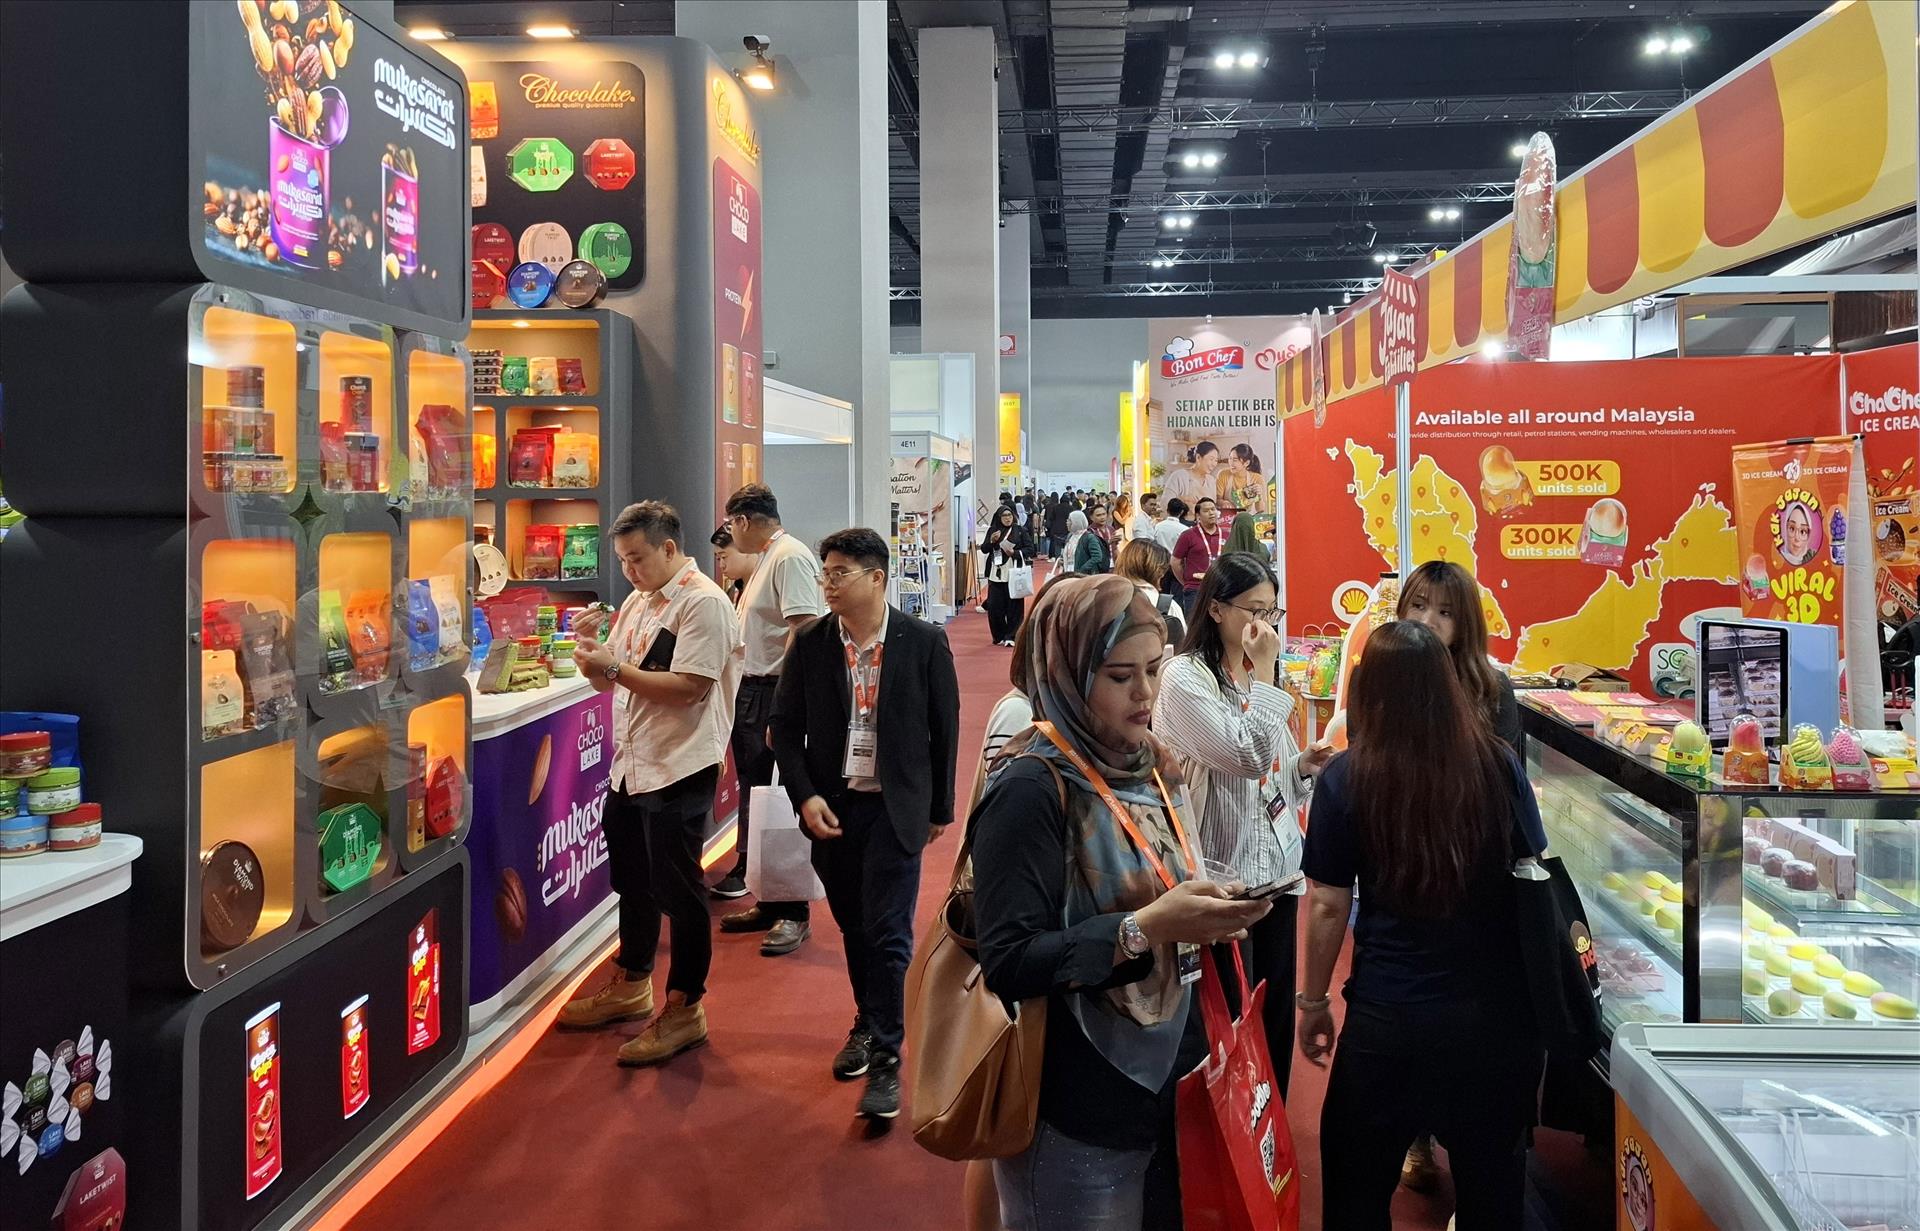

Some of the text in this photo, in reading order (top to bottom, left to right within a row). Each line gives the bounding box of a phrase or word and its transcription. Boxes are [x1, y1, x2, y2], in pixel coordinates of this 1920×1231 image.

[374, 58, 455, 125] mukasarat
[519, 73, 633, 104] Chocolake
[729, 196, 750, 224] CHOCO
[1171, 349, 1238, 376] Bon Chef
[1176, 399, 1275, 412] SETIAP DETIK BER
[1167, 414, 1276, 428] HIDANGAN LEBIH IS
[1415, 406, 1695, 426] Available all around Malaysia
[1472, 431, 1502, 439] through
[1503, 430, 1523, 438] retail,
[1524, 430, 1546, 438] petrol
[1578, 429, 1608, 437] vending
[1648, 427, 1692, 435] wholesalers
[1692, 427, 1707, 435] and
[1860, 418, 1880, 432] ICE
[900, 440, 916, 448] 4E11
[1539, 464, 1603, 481] 500K
[1824, 466, 1847, 474] CREAM
[1537, 482, 1607, 493] units sold
[1875, 504, 1910, 516] Ice Cream
[1510, 527, 1574, 545] 300K
[1507, 546, 1543, 557] units
[1547, 546, 1576, 557] sold
[1771, 567, 1835, 602] VIRAL
[1887, 584, 1899, 598] Ice
[1786, 593, 1820, 624] 3D
[578, 725, 604, 751] CHOCO
[583, 748, 599, 766] LAKE
[233, 859, 254, 890] DIAMOND
[31, 1109, 44, 1120] LAKE
[80, 1173, 118, 1205] LAKETWIST
